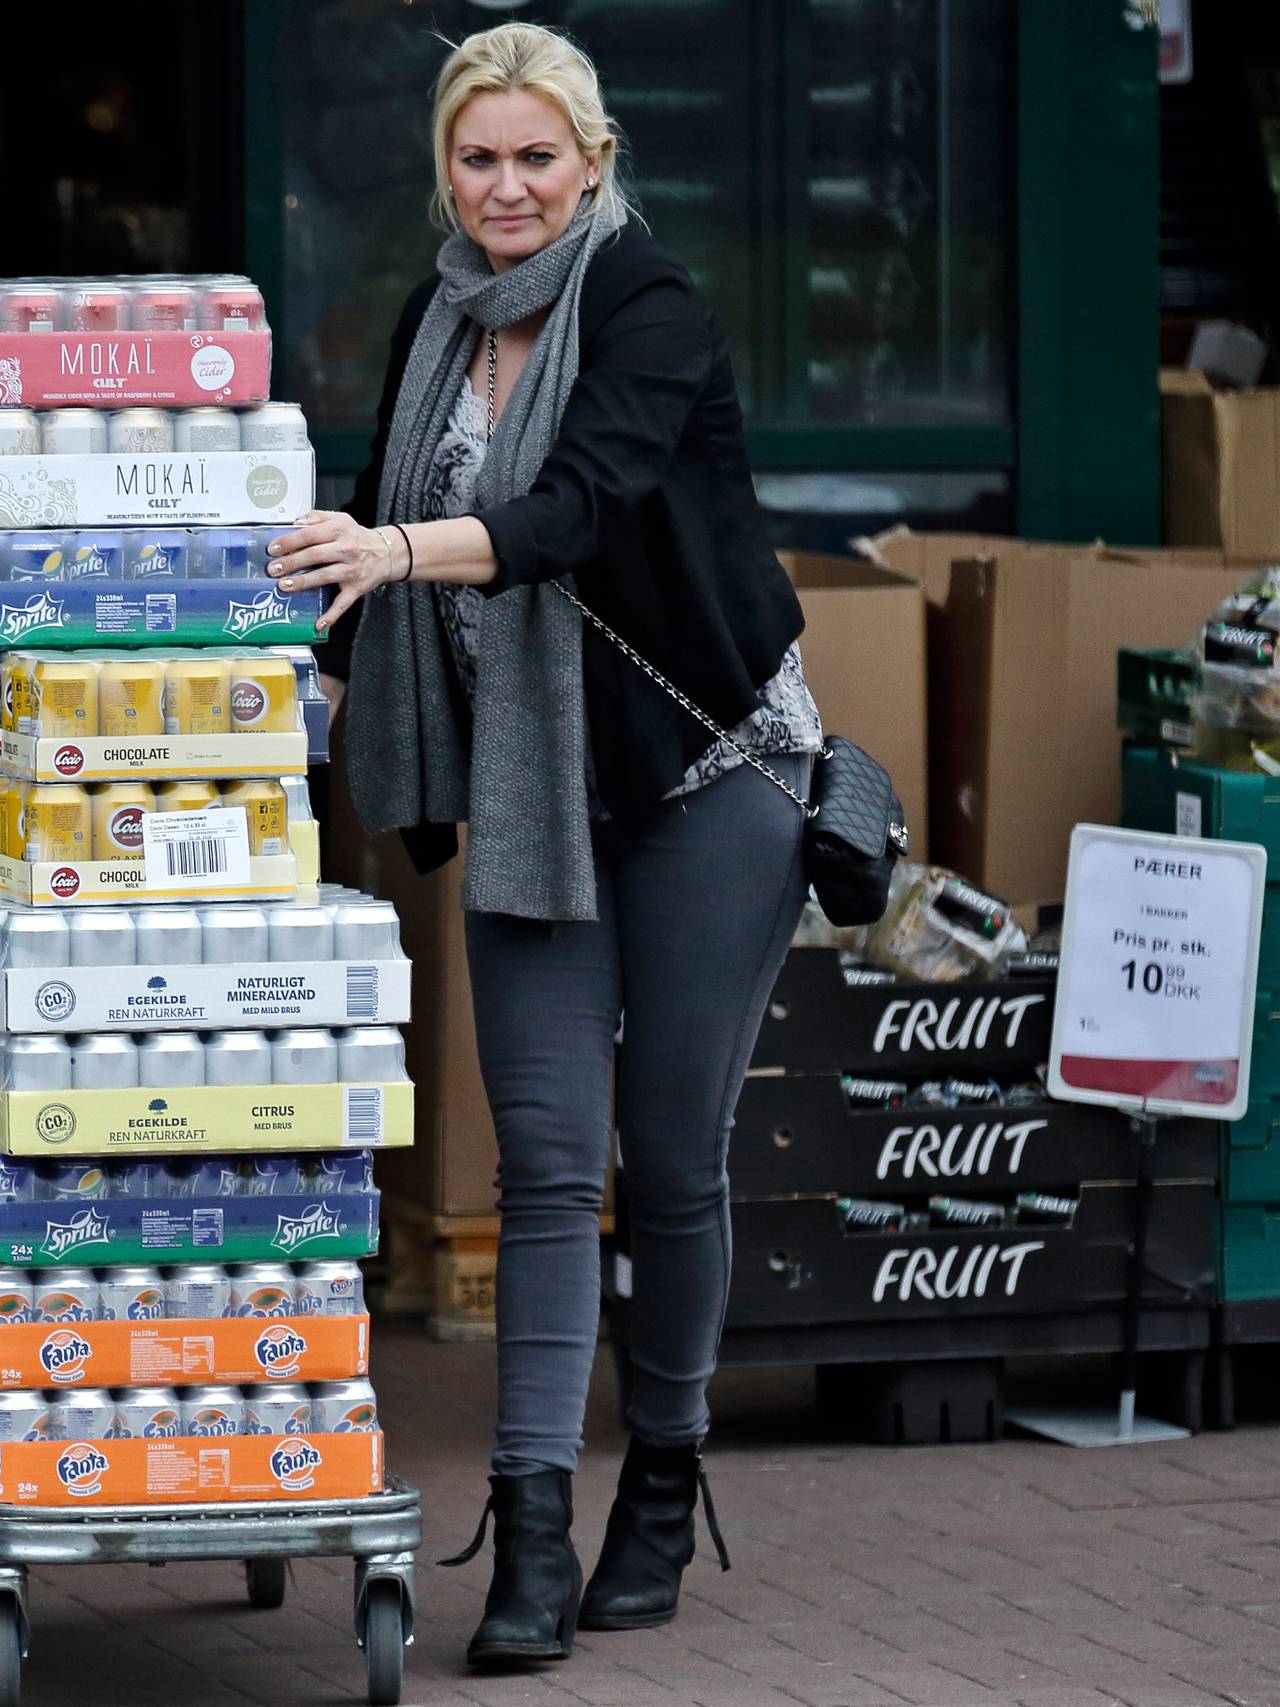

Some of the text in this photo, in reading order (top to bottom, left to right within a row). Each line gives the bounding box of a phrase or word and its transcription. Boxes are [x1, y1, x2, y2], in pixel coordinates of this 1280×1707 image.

[61, 338, 152, 375] MOKAÏ
[116, 459, 206, 495] MOKAÏ
[3, 602, 57, 636] Sprite
[231, 599, 284, 632] Sprite
[55, 750, 82, 765] Cocio
[104, 748, 170, 760] CHOCOLATE
[51, 872, 79, 887] Cocio
[1134, 857, 1202, 880] PÆRER
[1113, 928, 1212, 958] Pris pr. stk.
[237, 976, 306, 989] NATURLIGT
[1121, 960, 1163, 994] 10
[127, 995, 187, 1006] EGEKILDE
[227, 988, 316, 1002] MINERALVAND
[1164, 982, 1201, 1001] DKK
[108, 1007, 205, 1020] REN NATURKRAFT
[242, 1006, 301, 1015] MED MILD BRUS
[873, 994, 1046, 1053] FRUIT
[128, 1118, 188, 1128] EGEKILDE
[251, 1106, 295, 1117] CITRUS
[109, 1129, 206, 1142] REN NATURKRAFT
[272, 1122, 292, 1130] BRUS
[876, 1119, 1049, 1180] FRUIT
[48, 1218, 102, 1252] Sprite
[279, 1213, 332, 1246] Sprite
[11, 1245, 33, 1255] 24x
[872, 1241, 1046, 1303] FRUIT
[41, 1339, 90, 1371] Fanta
[257, 1335, 305, 1365] Fanta
[58, 1452, 106, 1483] Fanta
[272, 1447, 319, 1478] Fanta
[17, 1483, 39, 1493] 24x
